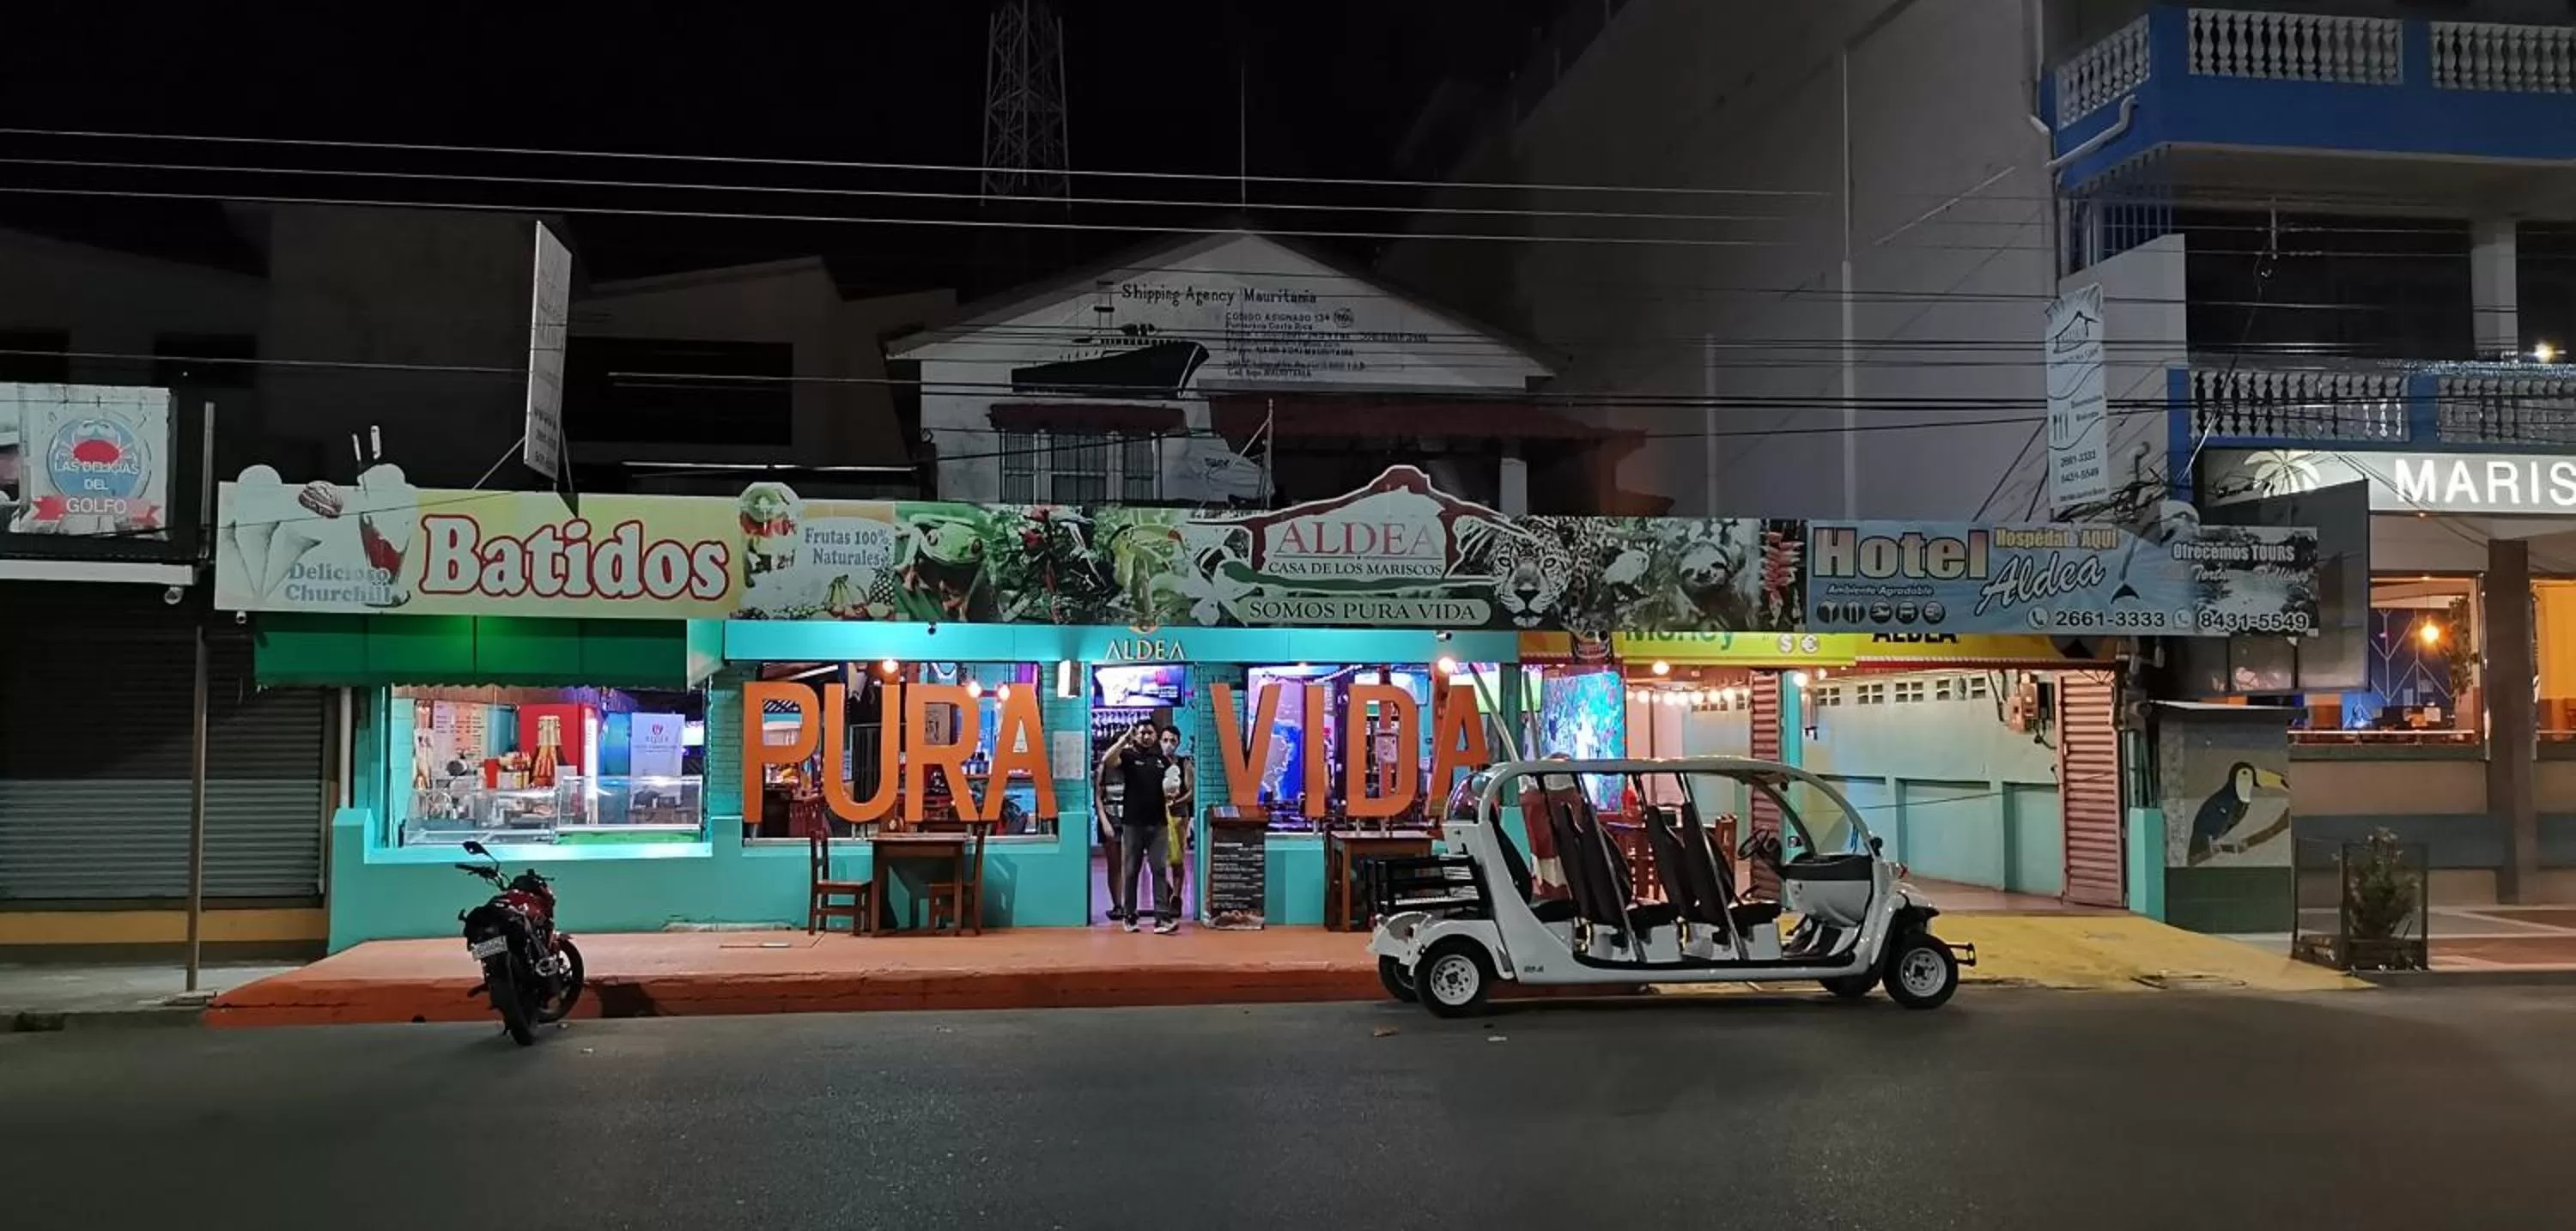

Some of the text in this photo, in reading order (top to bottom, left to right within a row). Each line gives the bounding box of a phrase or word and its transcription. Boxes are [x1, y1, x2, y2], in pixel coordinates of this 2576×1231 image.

[1121, 284, 1181, 306] Shipping
[1185, 287, 1234, 306] Agency
[84, 478, 109, 490] DEL
[66, 497, 127, 514] GOLFO
[805, 528, 889, 545] Frutas 100%
[1274, 521, 1440, 555] ALDEA
[420, 515, 729, 599] Batidos
[813, 548, 879, 566] Naturales
[1814, 527, 1989, 579] Hotel
[2173, 543, 2295, 561] Ofrecemos TOURS
[1268, 562, 1442, 576] CASA DE LOS MARISCOS
[1974, 552, 2105, 616] Aldea
[1249, 602, 1477, 621] SOMOS PURA VIDA
[2055, 611, 2166, 627] 2661-3333
[2200, 611, 2309, 630] 8431-5549
[1105, 639, 1185, 660] ALDEA
[742, 681, 1490, 824] PURA VIDA
